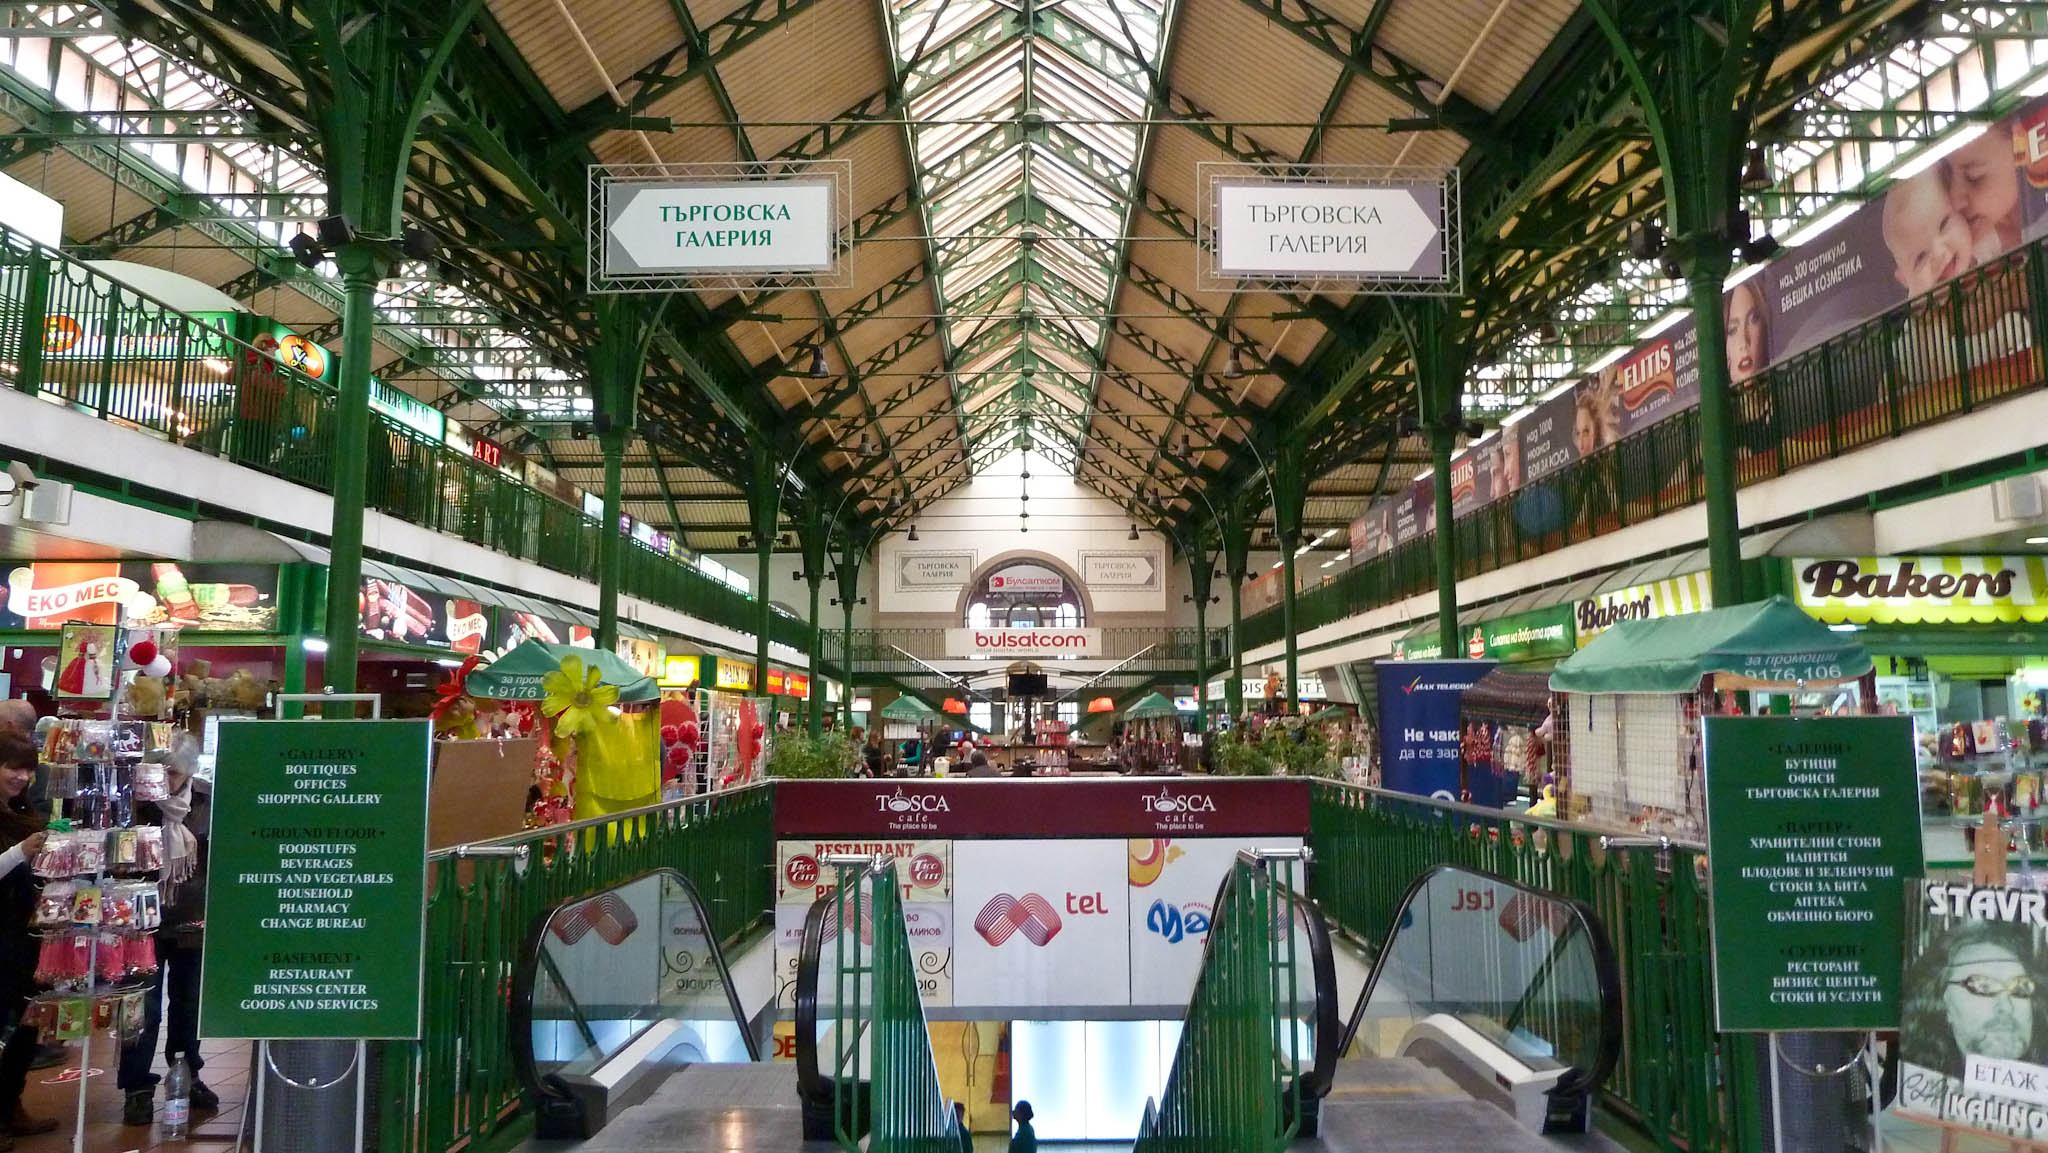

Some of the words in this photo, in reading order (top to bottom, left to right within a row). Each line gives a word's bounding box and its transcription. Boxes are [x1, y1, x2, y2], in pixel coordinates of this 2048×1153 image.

[659, 204, 791, 222] ТЪРГОВСКА
[1248, 205, 1382, 224] ТЪРГОВСКА
[676, 229, 772, 247] ГАЛЕРИЯ
[1270, 235, 1367, 253] ГАЛЕРИЯ
[1794, 260, 1808, 280] 300
[1815, 255, 1862, 294] КОЗМЕТИКА
[1624, 344, 1671, 392] ELITIS
[474, 440, 500, 467] ART
[1802, 560, 2016, 598] Bakers
[1578, 595, 1651, 630] Bakers
[975, 632, 1086, 648] bulsatcom
[1745, 668, 1796, 682] 9176
[1804, 665, 1842, 681] 106
[499, 687, 537, 698] 9176
[1404, 728, 1424, 742] Не
[287, 750, 356, 760] GALLERY
[1399, 748, 1415, 760] да
[1419, 749, 1433, 758] се
[1436, 748, 1459, 761] зар
[285, 764, 357, 775] BOUTIQUES
[1785, 759, 1837, 769] БУТИЦИ
[294, 779, 347, 789] OFFICES
[1788, 773, 1836, 785] ОФИСИ
[1745, 788, 1820, 798] ТЪРГОВСКА
[1822, 788, 1880, 798] ГАЛЕРИЯ
[257, 794, 320, 804] SHOPPING
[323, 794, 382, 804] GALLERY
[876, 795, 950, 812] TOSCA
[1142, 795, 1216, 812] TOSCA
[899, 814, 928, 822] cafe
[1165, 814, 1194, 822] cafe
[889, 822, 900, 830] The
[902, 822, 919, 831] place
[921, 822, 928, 830] to
[929, 822, 937, 830] be
[1170, 823, 1187, 831] place
[260, 828, 323, 839] GROUND
[327, 828, 377, 839] FLOOR
[279, 844, 356, 854] FOODSTUFFS
[1750, 838, 1835, 849] ХРАНИТЕЛНИ
[1837, 838, 1881, 848] СТОКИ
[815, 843, 915, 858] RESTAURANT
[1785, 853, 1848, 863] НАПИТКИ
[281, 859, 353, 869] BEVERAGES
[1742, 867, 1801, 879] ПЛОДОВЕ
[1805, 867, 1815, 877] И
[1818, 867, 1894, 878] ЗЕЛЕНЧУЦИ
[239, 874, 282, 884] FRUITS
[284, 874, 311, 884] AND
[314, 874, 393, 884] VEGETABLES
[1769, 882, 1813, 892] СТОКИ
[1816, 882, 1831, 892] ЗА
[1834, 882, 1867, 892] БИТА
[278, 889, 353, 899] HOUSEHOLD
[1066, 892, 1108, 915] tel
[1794, 896, 1844, 907] АПТЕКА
[279, 904, 350, 914] PHARMACY
[1767, 911, 1832, 922] ОБМЕННО
[1835, 911, 1873, 921] БЮРО
[261, 918, 314, 929] CHANGE
[317, 918, 367, 929] BUREAU
[272, 953, 352, 964] BASEMENT
[1787, 962, 1860, 972] РЕСТОРАНТ
[269, 969, 353, 979] RESTAURANT
[1773, 977, 1822, 987] БИЗНЕС
[1826, 977, 1878, 988] ЦЕНТЪР
[254, 984, 313, 995] BUSINESS
[316, 984, 367, 995] CENTER
[1770, 991, 1814, 1002] СТОКИ
[1817, 991, 1826, 1002] И
[1829, 991, 1882, 1002] УСЛУГИ
[240, 999, 285, 1010] GOODS
[288, 999, 314, 1010] AND
[317, 999, 378, 1010] SERVICES
[1975, 1063, 2040, 1091] ЕТАЖ
